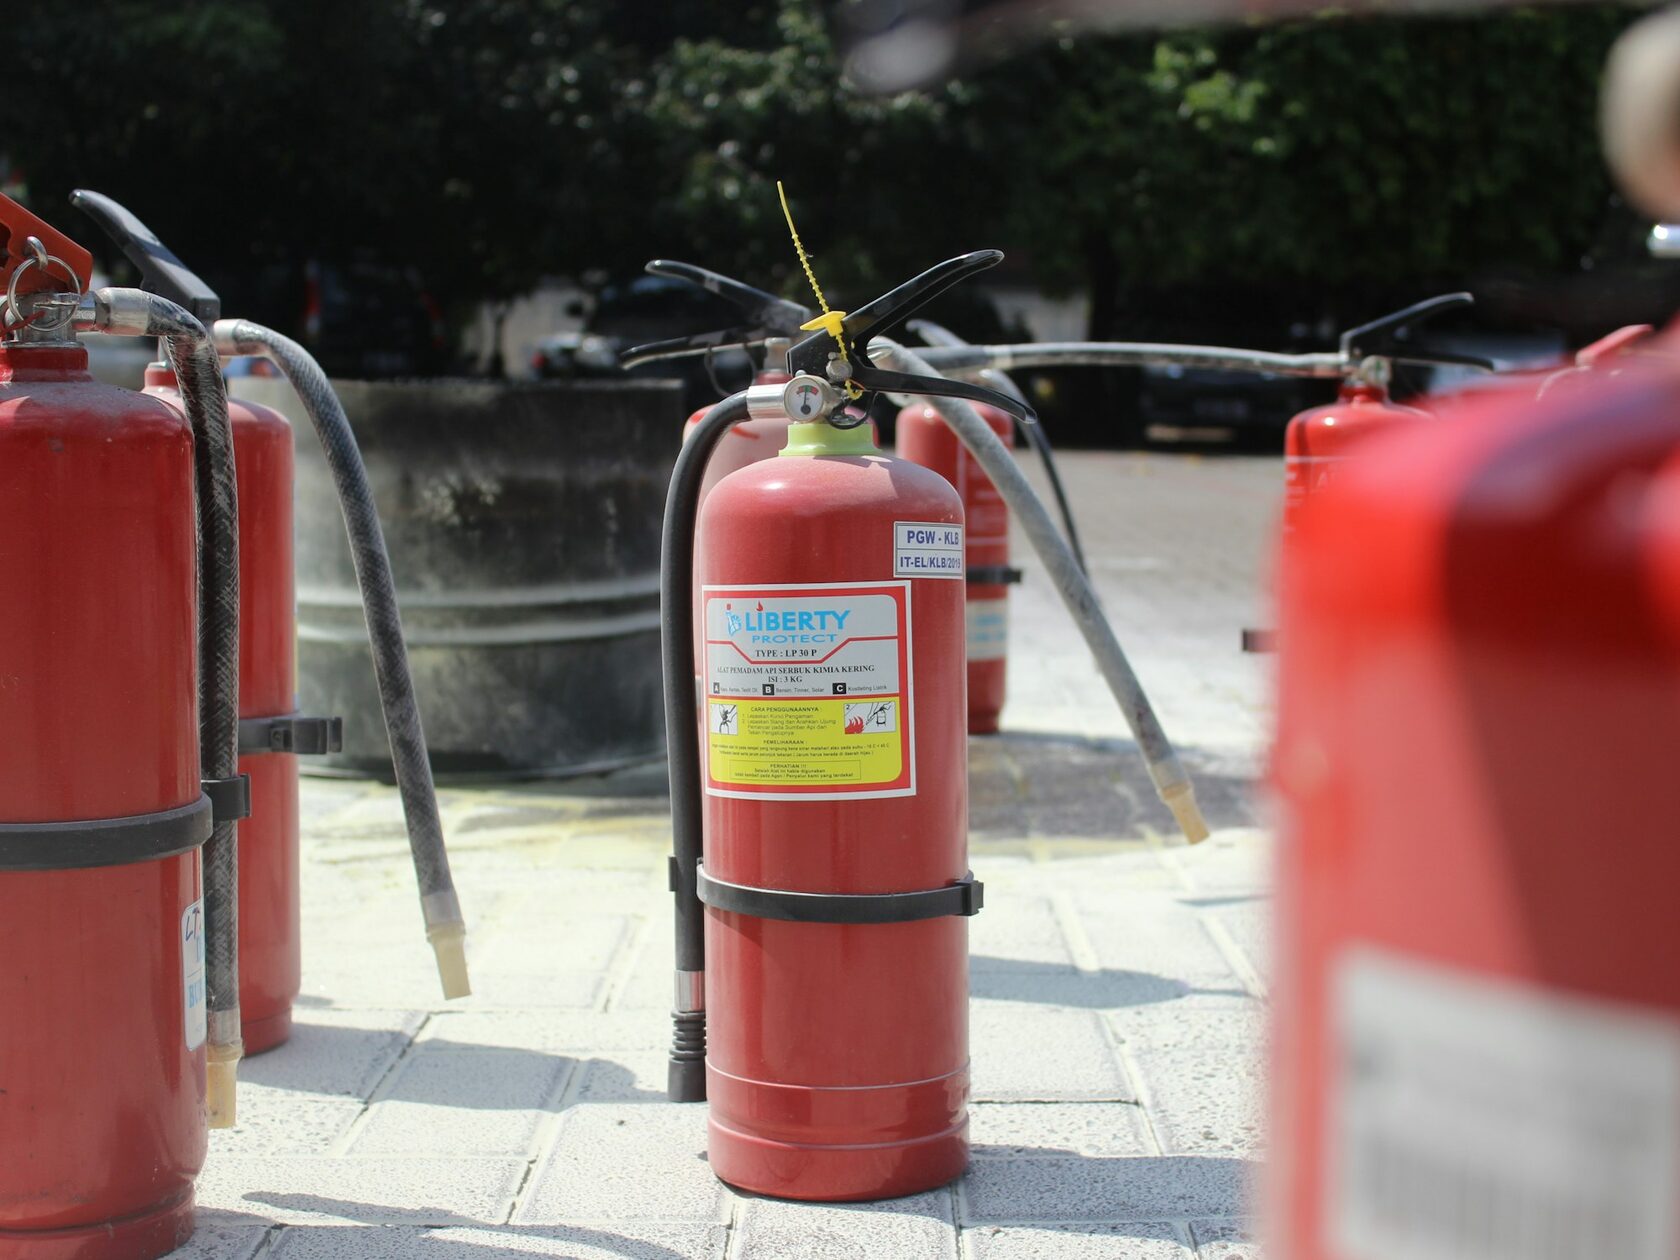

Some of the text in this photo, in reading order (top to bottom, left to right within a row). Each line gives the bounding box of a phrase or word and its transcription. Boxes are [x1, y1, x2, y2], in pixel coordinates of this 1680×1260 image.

[907, 530, 935, 544] PGW
[944, 531, 959, 545] KLB
[746, 609, 851, 631] LIBERTY
[751, 633, 837, 644] PROTECT
[755, 649, 778, 657] TYPE
[785, 649, 798, 657] LP
[799, 649, 809, 657] 30
[811, 648, 818, 657] P
[730, 666, 763, 675] PEMADAM
[765, 666, 777, 674] API
[778, 666, 811, 674] SERBUK
[813, 665, 839, 674] KIMIA
[841, 664, 875, 673] KERING
[768, 675, 778, 683] ISI
[790, 675, 803, 683] KG
